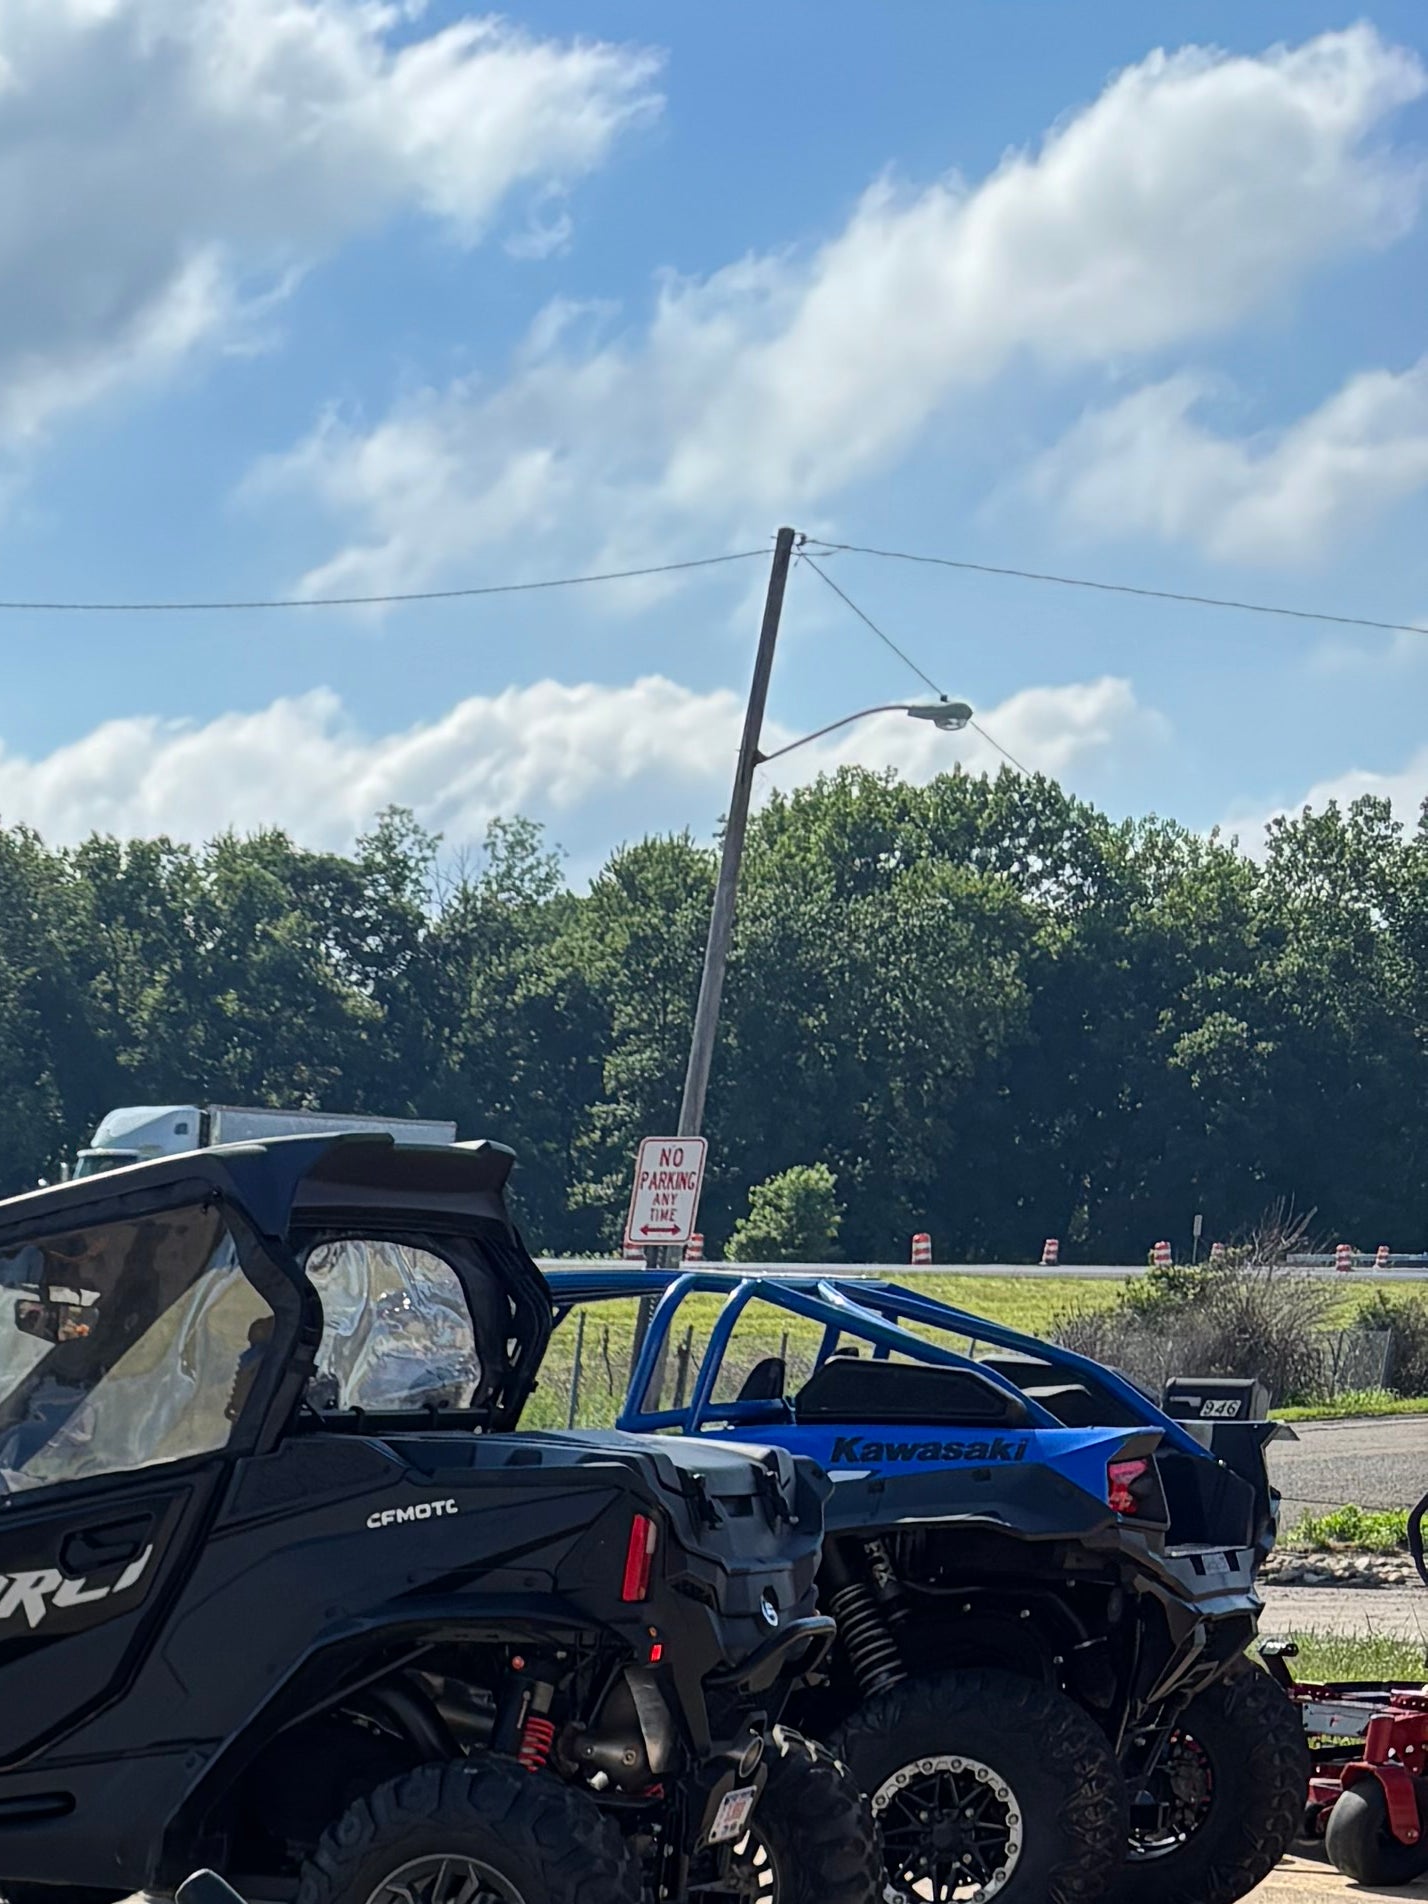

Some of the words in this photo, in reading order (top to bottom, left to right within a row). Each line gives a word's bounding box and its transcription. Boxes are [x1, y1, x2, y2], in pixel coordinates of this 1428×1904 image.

[659, 1147, 684, 1168] NO
[640, 1171, 697, 1191] PARKING
[652, 1193, 679, 1206] ANY
[650, 1208, 678, 1222] TIME
[1203, 1400, 1239, 1417] 946
[830, 1436, 1030, 1464] Kawasaki
